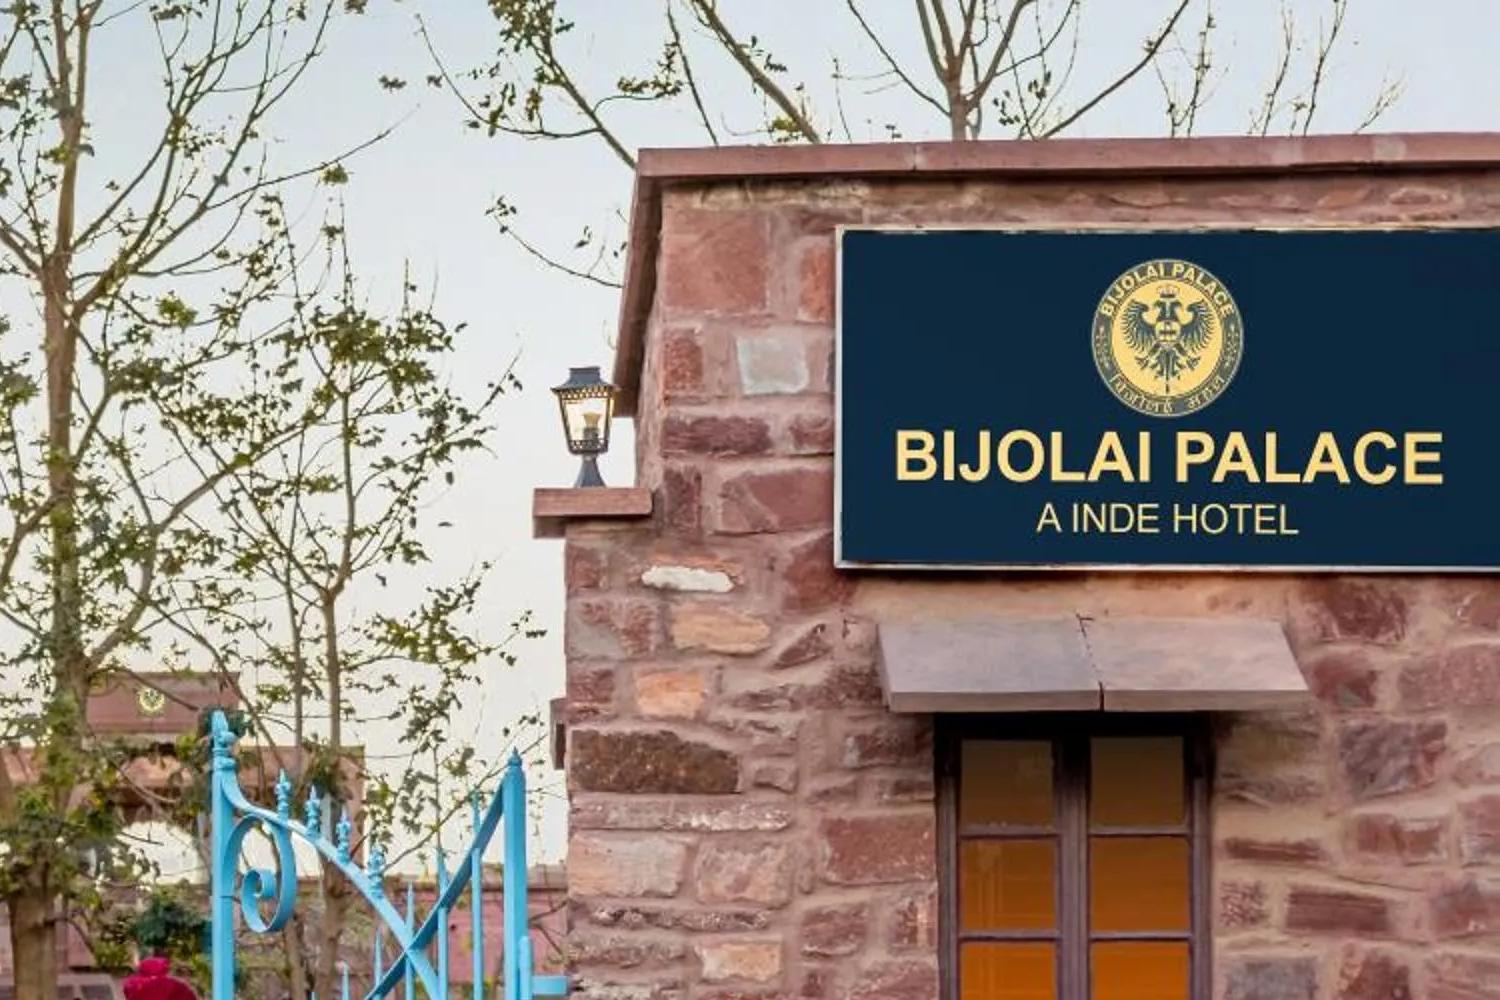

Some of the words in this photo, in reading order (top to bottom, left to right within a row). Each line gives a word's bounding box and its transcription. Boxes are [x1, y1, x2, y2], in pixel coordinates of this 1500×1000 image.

[1100, 263, 1166, 317] BIJOLAI
[1172, 263, 1236, 318] PALACE
[896, 430, 1150, 482] BIJOLAI
[1176, 431, 1443, 484] PALACE
[1037, 503, 1062, 532] A
[1073, 503, 1160, 533] INDE
[1173, 503, 1299, 535] HOTEL
